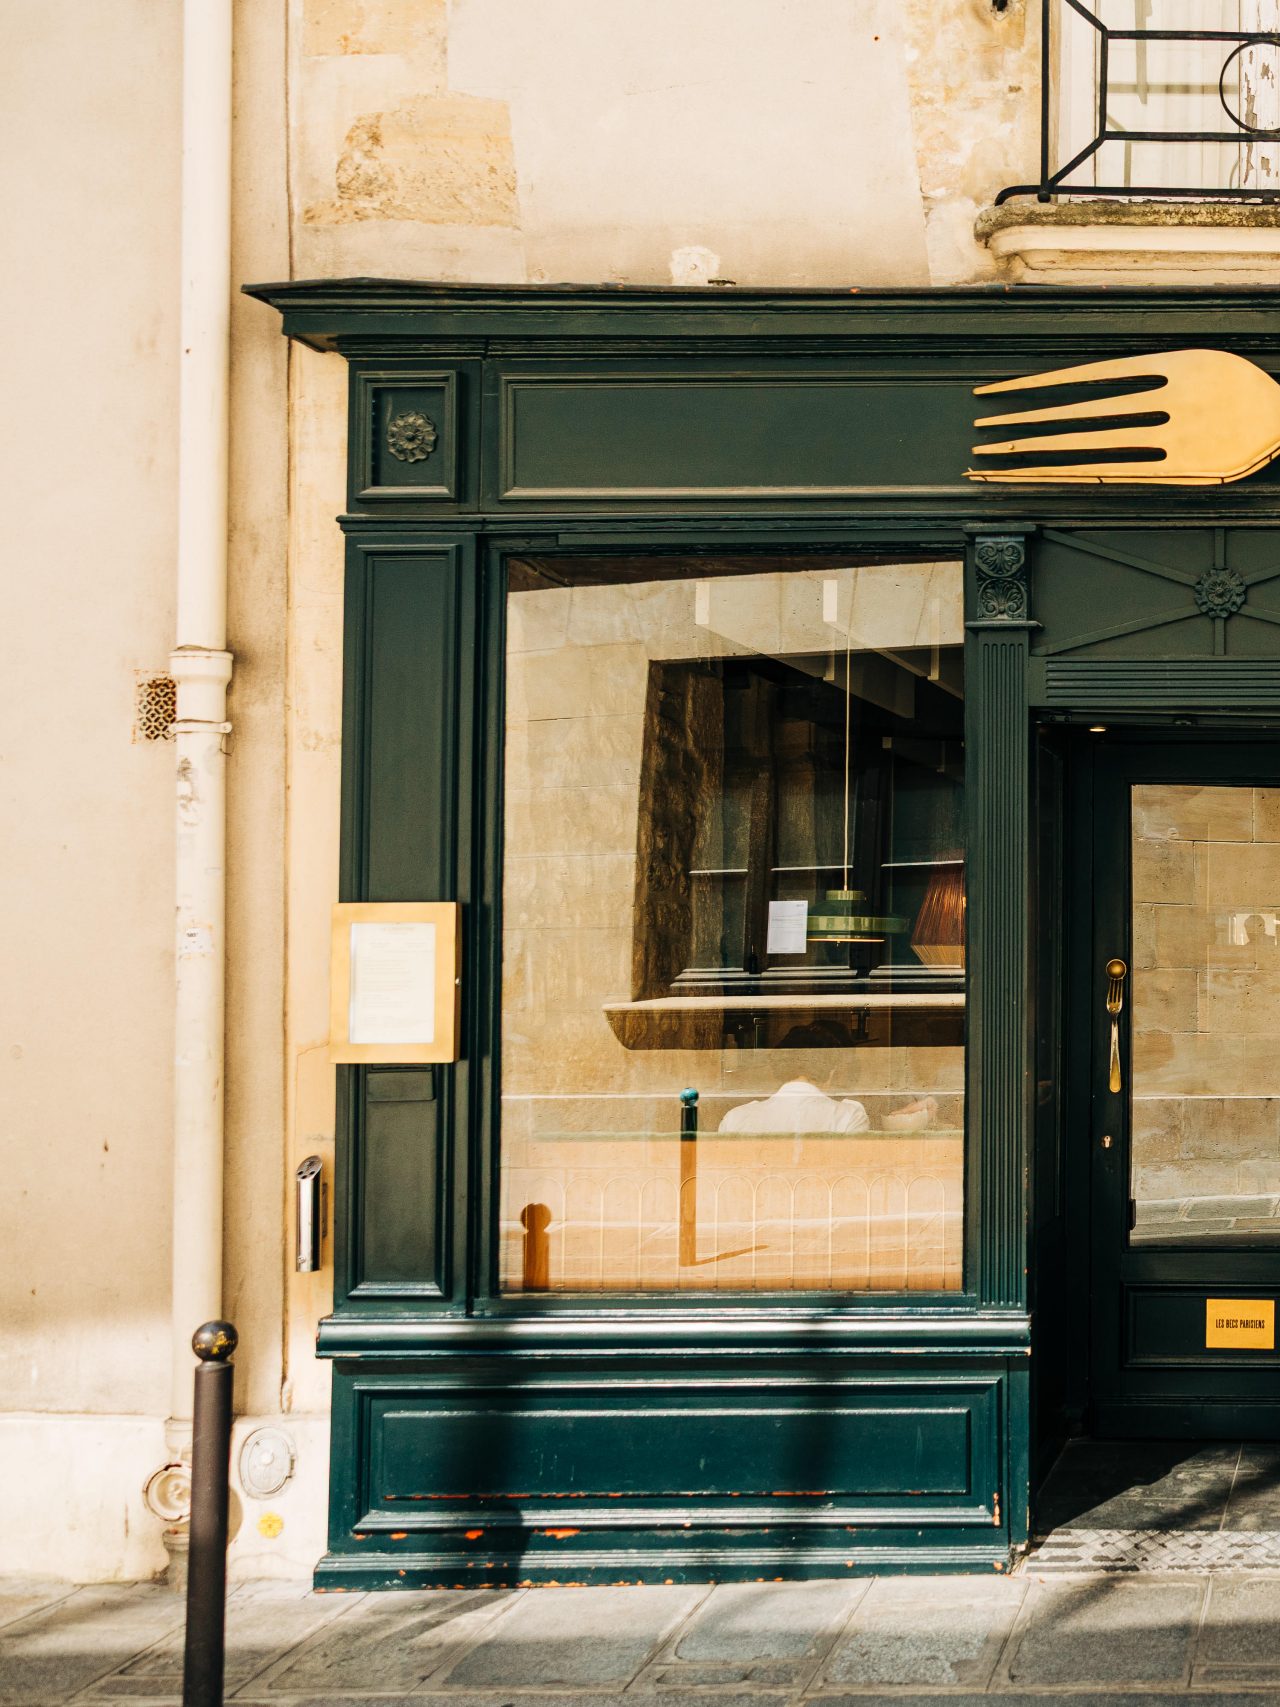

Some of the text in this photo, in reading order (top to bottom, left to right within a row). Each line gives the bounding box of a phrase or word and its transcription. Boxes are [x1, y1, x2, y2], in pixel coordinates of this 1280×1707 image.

[1216, 1319, 1265, 1329] LES BECS PARISIENS
